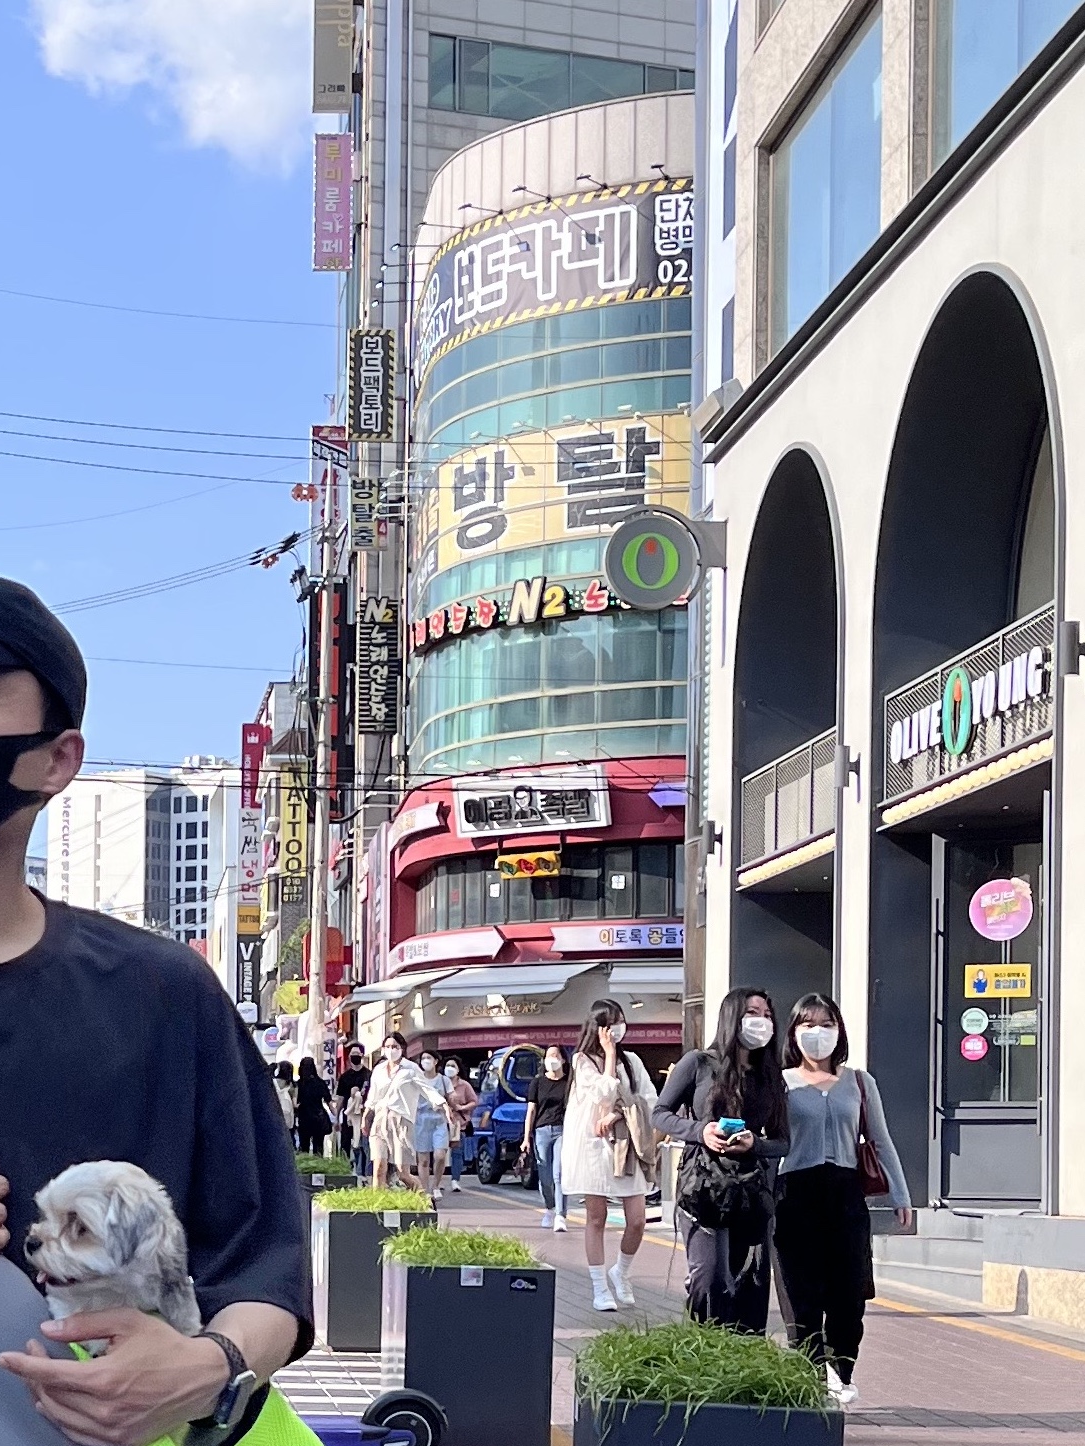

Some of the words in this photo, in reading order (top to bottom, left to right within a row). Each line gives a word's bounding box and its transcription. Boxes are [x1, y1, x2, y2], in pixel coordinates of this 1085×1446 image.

[360, 336, 384, 433] 보드팩토리
[61, 796, 72, 858] Mercure
[285, 766, 303, 876] TATTOO
[599, 928, 643, 945] 이토록
